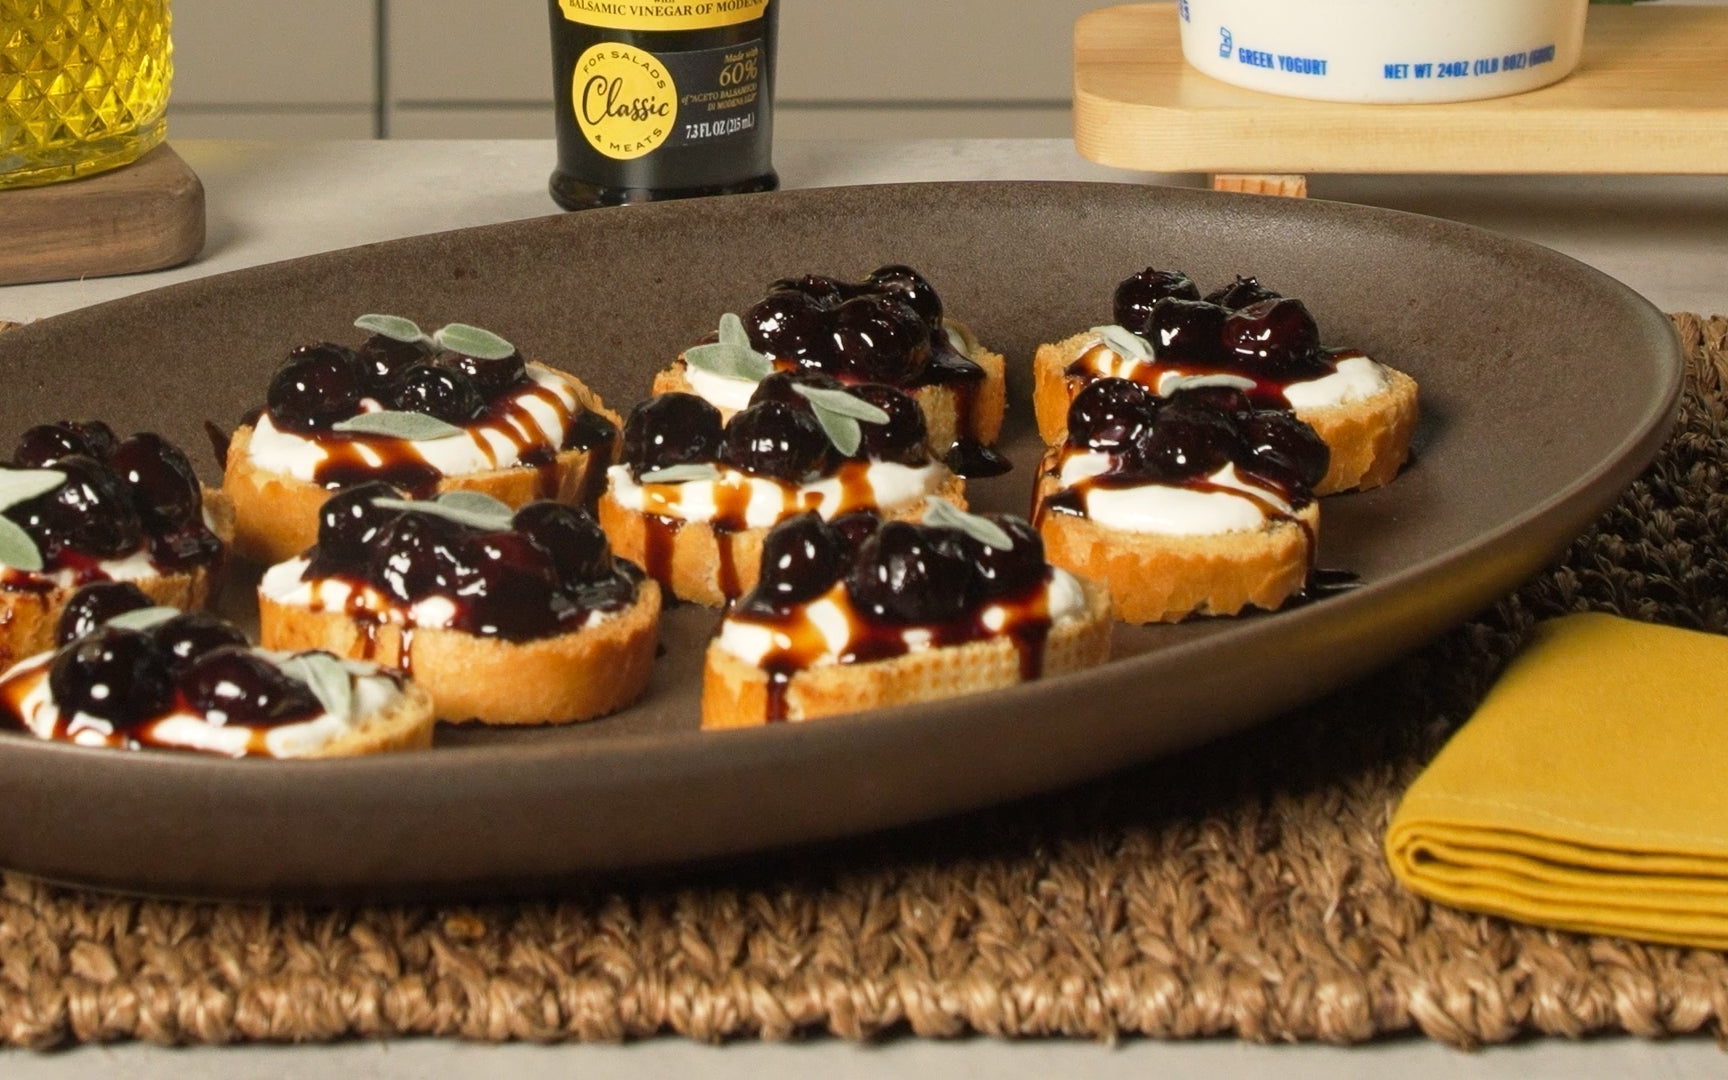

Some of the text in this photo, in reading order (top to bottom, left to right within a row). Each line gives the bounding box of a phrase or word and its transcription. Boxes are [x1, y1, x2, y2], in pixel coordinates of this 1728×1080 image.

[630, 5, 693, 17] VINEGAR
[695, 3, 714, 15] OF
[583, 50, 666, 89] FOR SALADS
[725, 51, 745, 64] Made
[1238, 47, 1328, 76] GREEK YOGURT
[719, 59, 759, 86] 60%
[1384, 64, 1409, 80] NET
[1415, 63, 1434, 79] WT
[1437, 60, 1469, 78] 24OZ
[582, 75, 670, 126] Classic
[609, 128, 663, 152] MEATS
[686, 124, 699, 139] 7.3
[700, 122, 711, 138] FL
[713, 119, 726, 136] OZ
